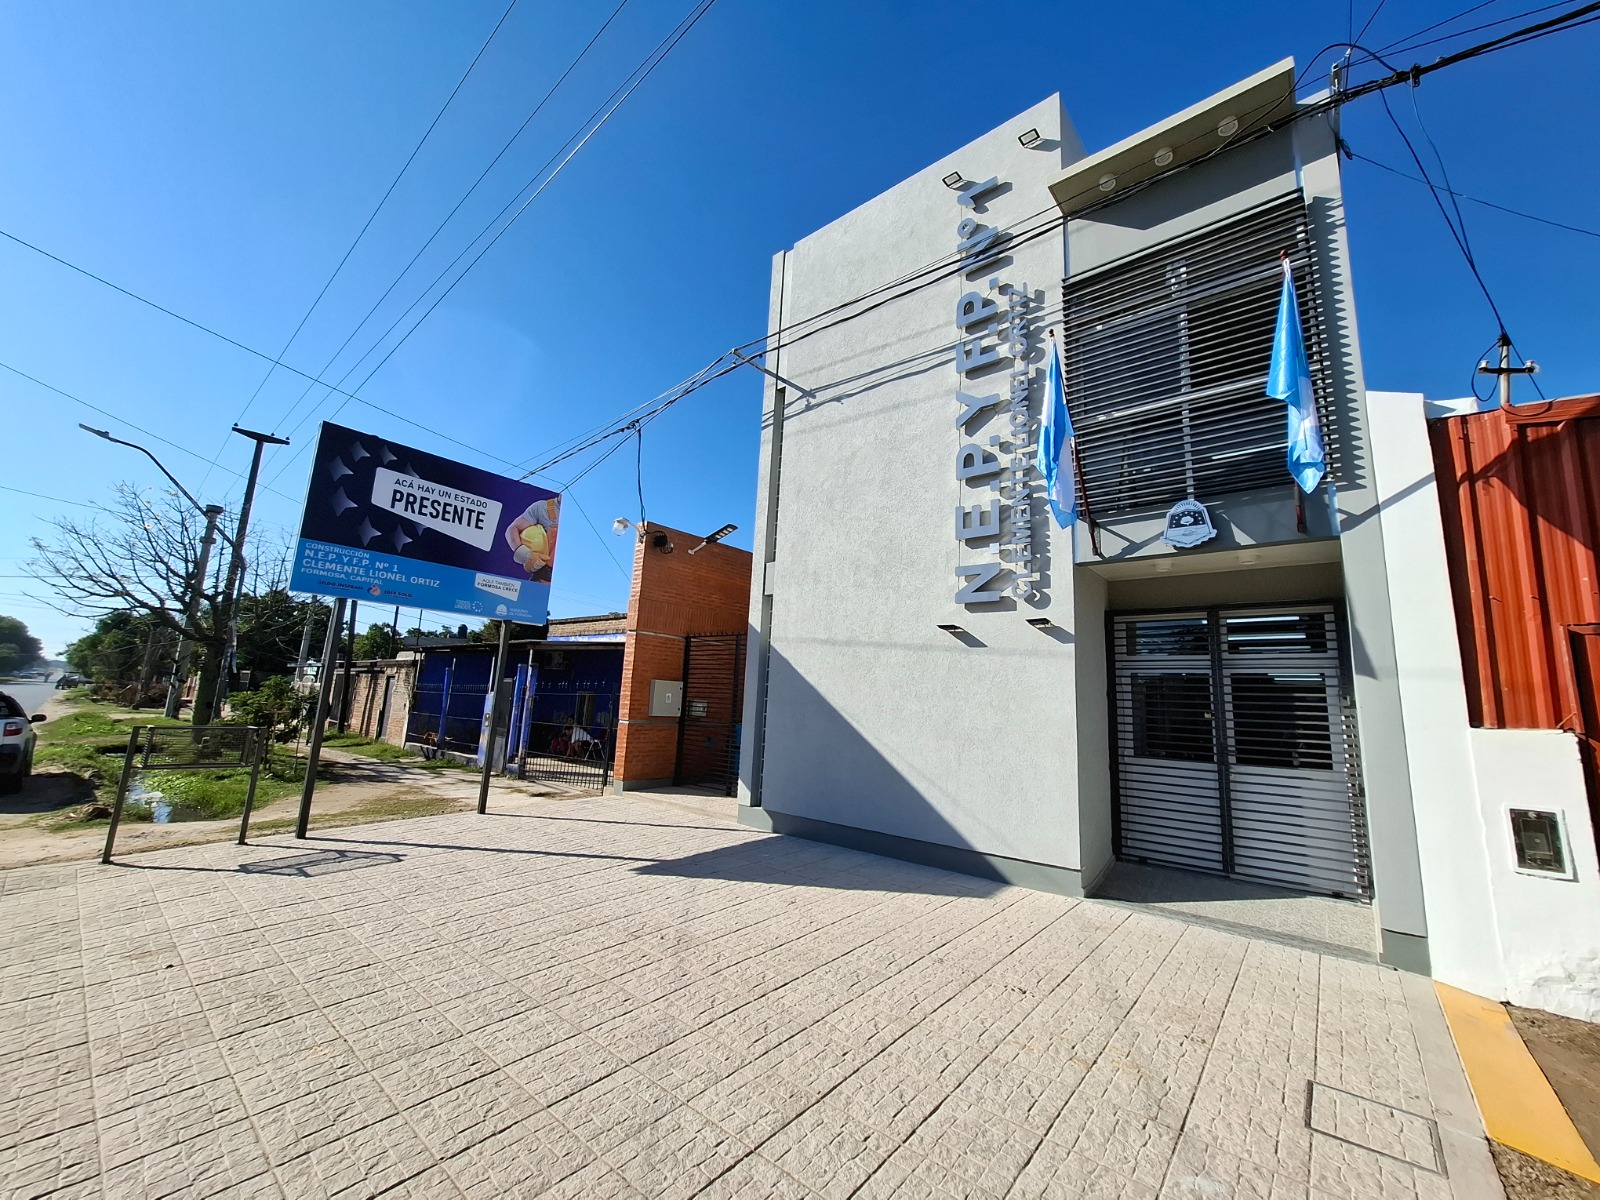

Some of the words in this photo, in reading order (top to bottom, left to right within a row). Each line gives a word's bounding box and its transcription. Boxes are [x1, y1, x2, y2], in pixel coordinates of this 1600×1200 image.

[956, 175, 999, 209] 1
[956, 277, 1000, 374] F.P.
[1008, 282, 1028, 357] ORTIZ
[955, 391, 1001, 430] Y
[1009, 357, 1030, 453] LIONEL
[390, 488, 486, 530] PRESENTE
[394, 478, 414, 490] ACÁ
[417, 484, 436, 495] HAY
[438, 489, 452, 499] UN
[454, 493, 488, 509] ESTADO
[955, 435, 1001, 604] N.E.P.
[1010, 456, 1032, 600] CLEMENTE
[304, 549, 338, 562] N.E.P.
[342, 555, 350, 564] Y
[352, 558, 371, 568] F.P.
[392, 564, 399, 572] 1
[305, 542, 370, 559] CONSTRUCCIÓN
[302, 558, 366, 576] CLEMENTE
[369, 569, 407, 583] LIONEL
[410, 576, 441, 588] ORTIZ
[350, 575, 384, 586] CAPITAL
[477, 581, 502, 591] FORMOSA
[502, 585, 519, 593] CRECE
